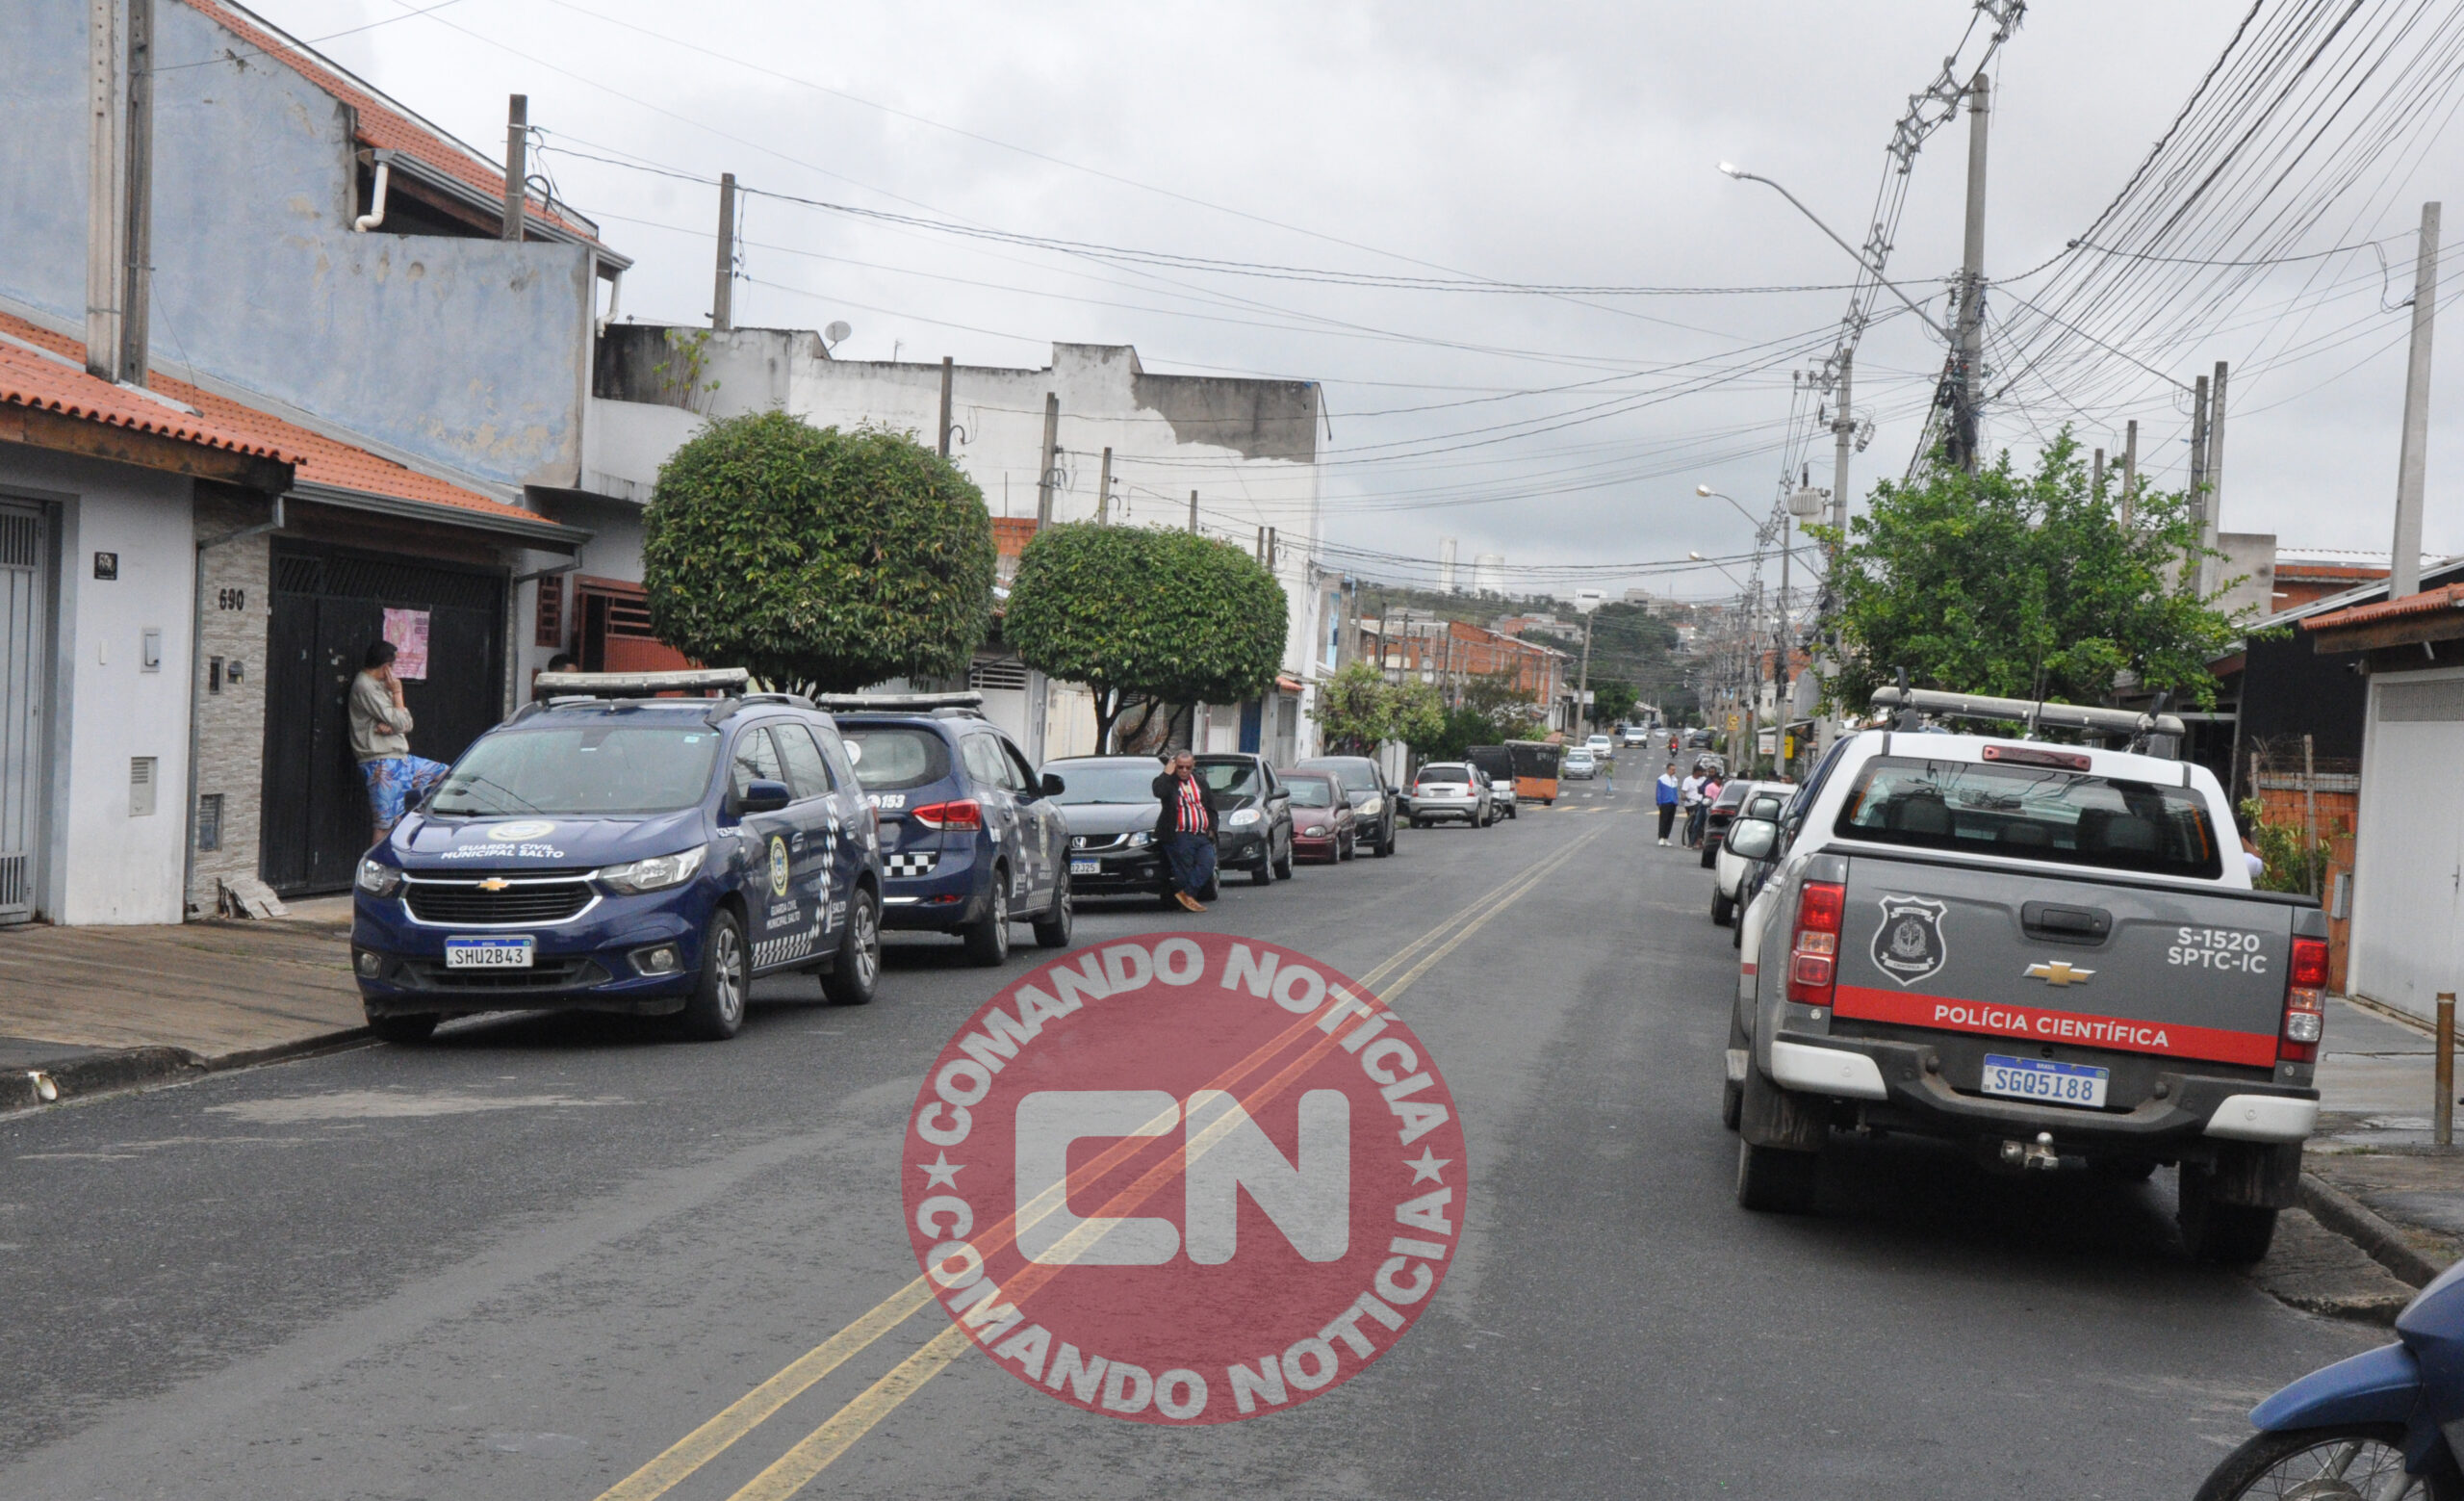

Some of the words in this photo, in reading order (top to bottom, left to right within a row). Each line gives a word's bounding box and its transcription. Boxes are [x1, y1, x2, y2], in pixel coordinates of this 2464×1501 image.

[219, 588, 244, 610] 690
[882, 794, 906, 809] 153
[441, 850, 514, 859] MUNICIPAL
[771, 902, 787, 917] GUARDA
[787, 900, 797, 911] CIVIL
[766, 915, 787, 930] MUNICIPAL
[787, 911, 801, 923] SALTO
[2177, 927, 2260, 952] S-1520
[455, 948, 523, 965] SHU2B43
[2168, 946, 2268, 973] SPTC-IC
[1934, 1004, 2028, 1031] POLÍCIA
[2037, 1017, 2169, 1048] CIENTÍFICA
[1995, 1070, 2093, 1100] SGQ5I88
